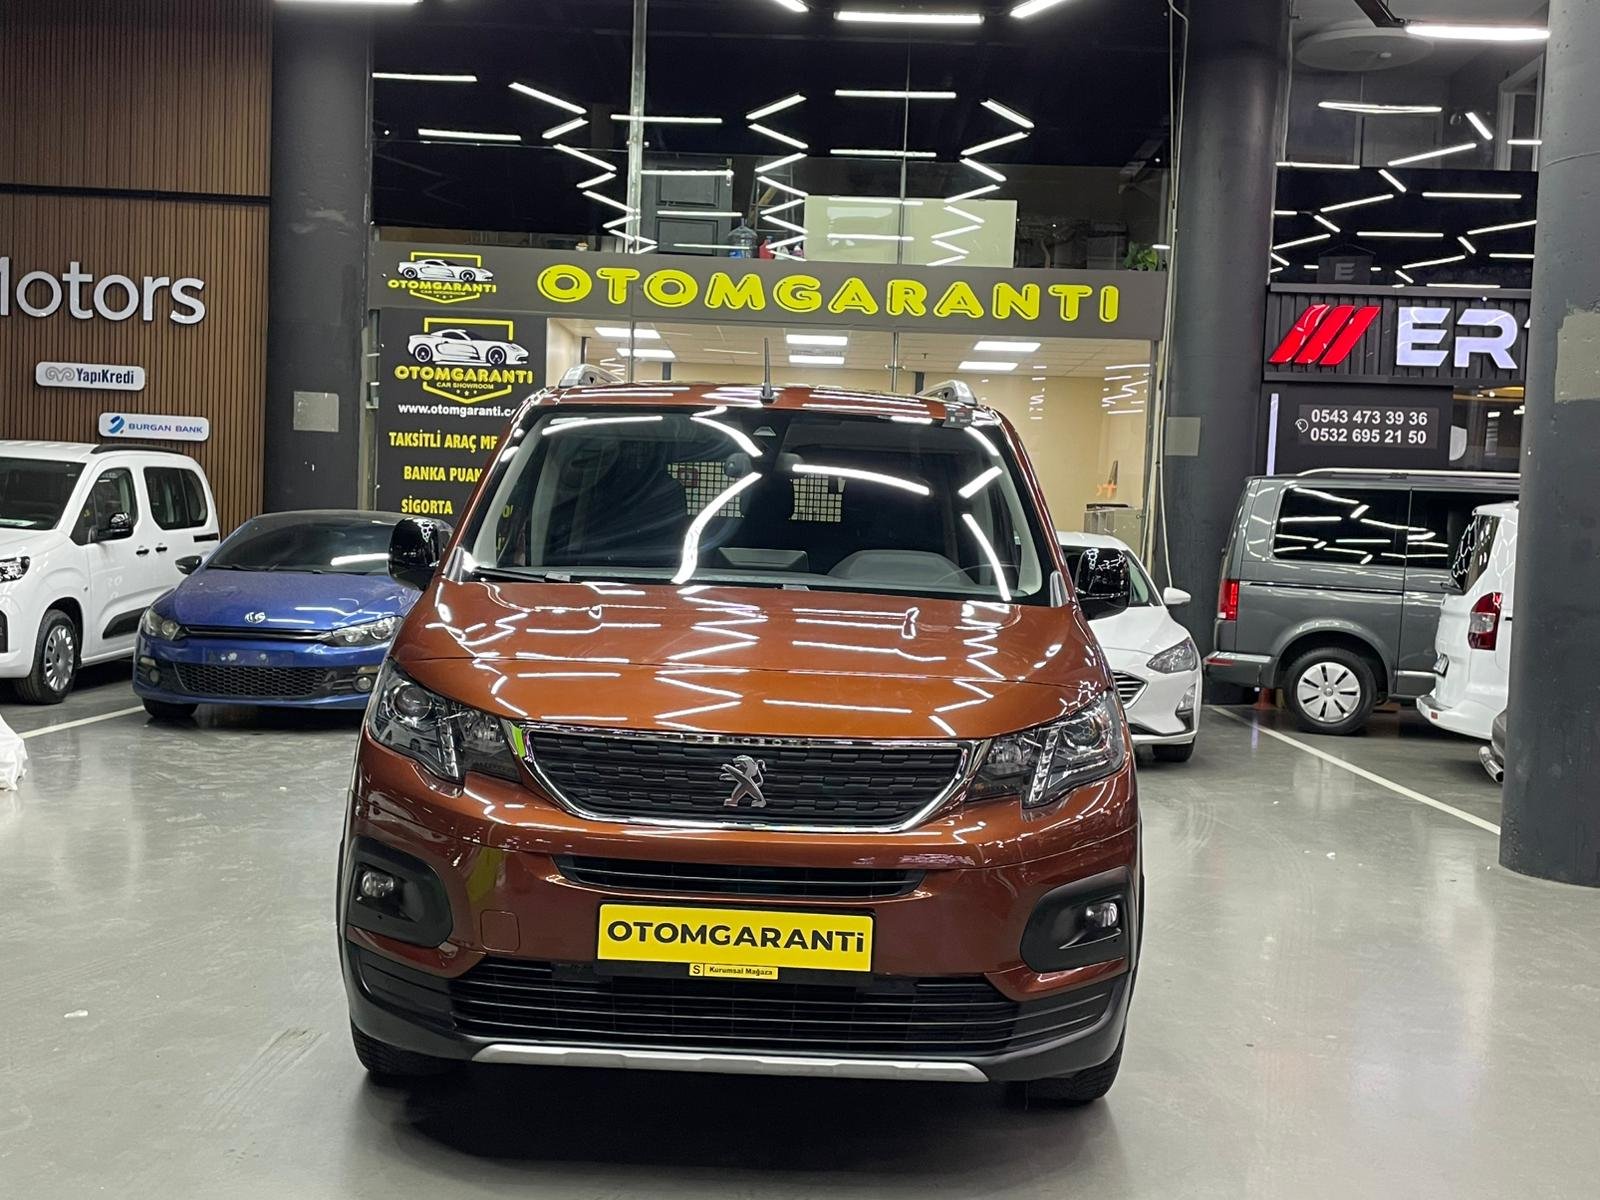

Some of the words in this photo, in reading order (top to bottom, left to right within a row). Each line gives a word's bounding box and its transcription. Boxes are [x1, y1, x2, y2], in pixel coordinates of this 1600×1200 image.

[0, 256, 206, 325] otors
[388, 279, 497, 293] OTOMGARANTI
[537, 264, 1121, 323] OTOMGARANTI
[1396, 307, 1531, 369] ER
[394, 366, 533, 384] OTOMGARANTI
[1311, 409, 1348, 423] 0543
[1353, 410, 1381, 424] 473
[1385, 411, 1405, 425] 39
[1409, 412, 1428, 425] 36
[128, 423, 172, 432] BURGAN
[175, 425, 203, 433] BANK
[1310, 428, 1348, 441] 0532
[1352, 429, 1380, 442] 695
[1384, 430, 1402, 443] 21
[1408, 430, 1427, 444] 50
[389, 429, 441, 447] TAKSİTLİ
[444, 434, 477, 453] ARAÇ
[404, 466, 446, 481] BANKA
[401, 496, 453, 514] SİGORTA
[693, 965, 700, 974] S
[709, 966, 743, 974] Kurumsal
[745, 968, 772, 976] Mağaza
